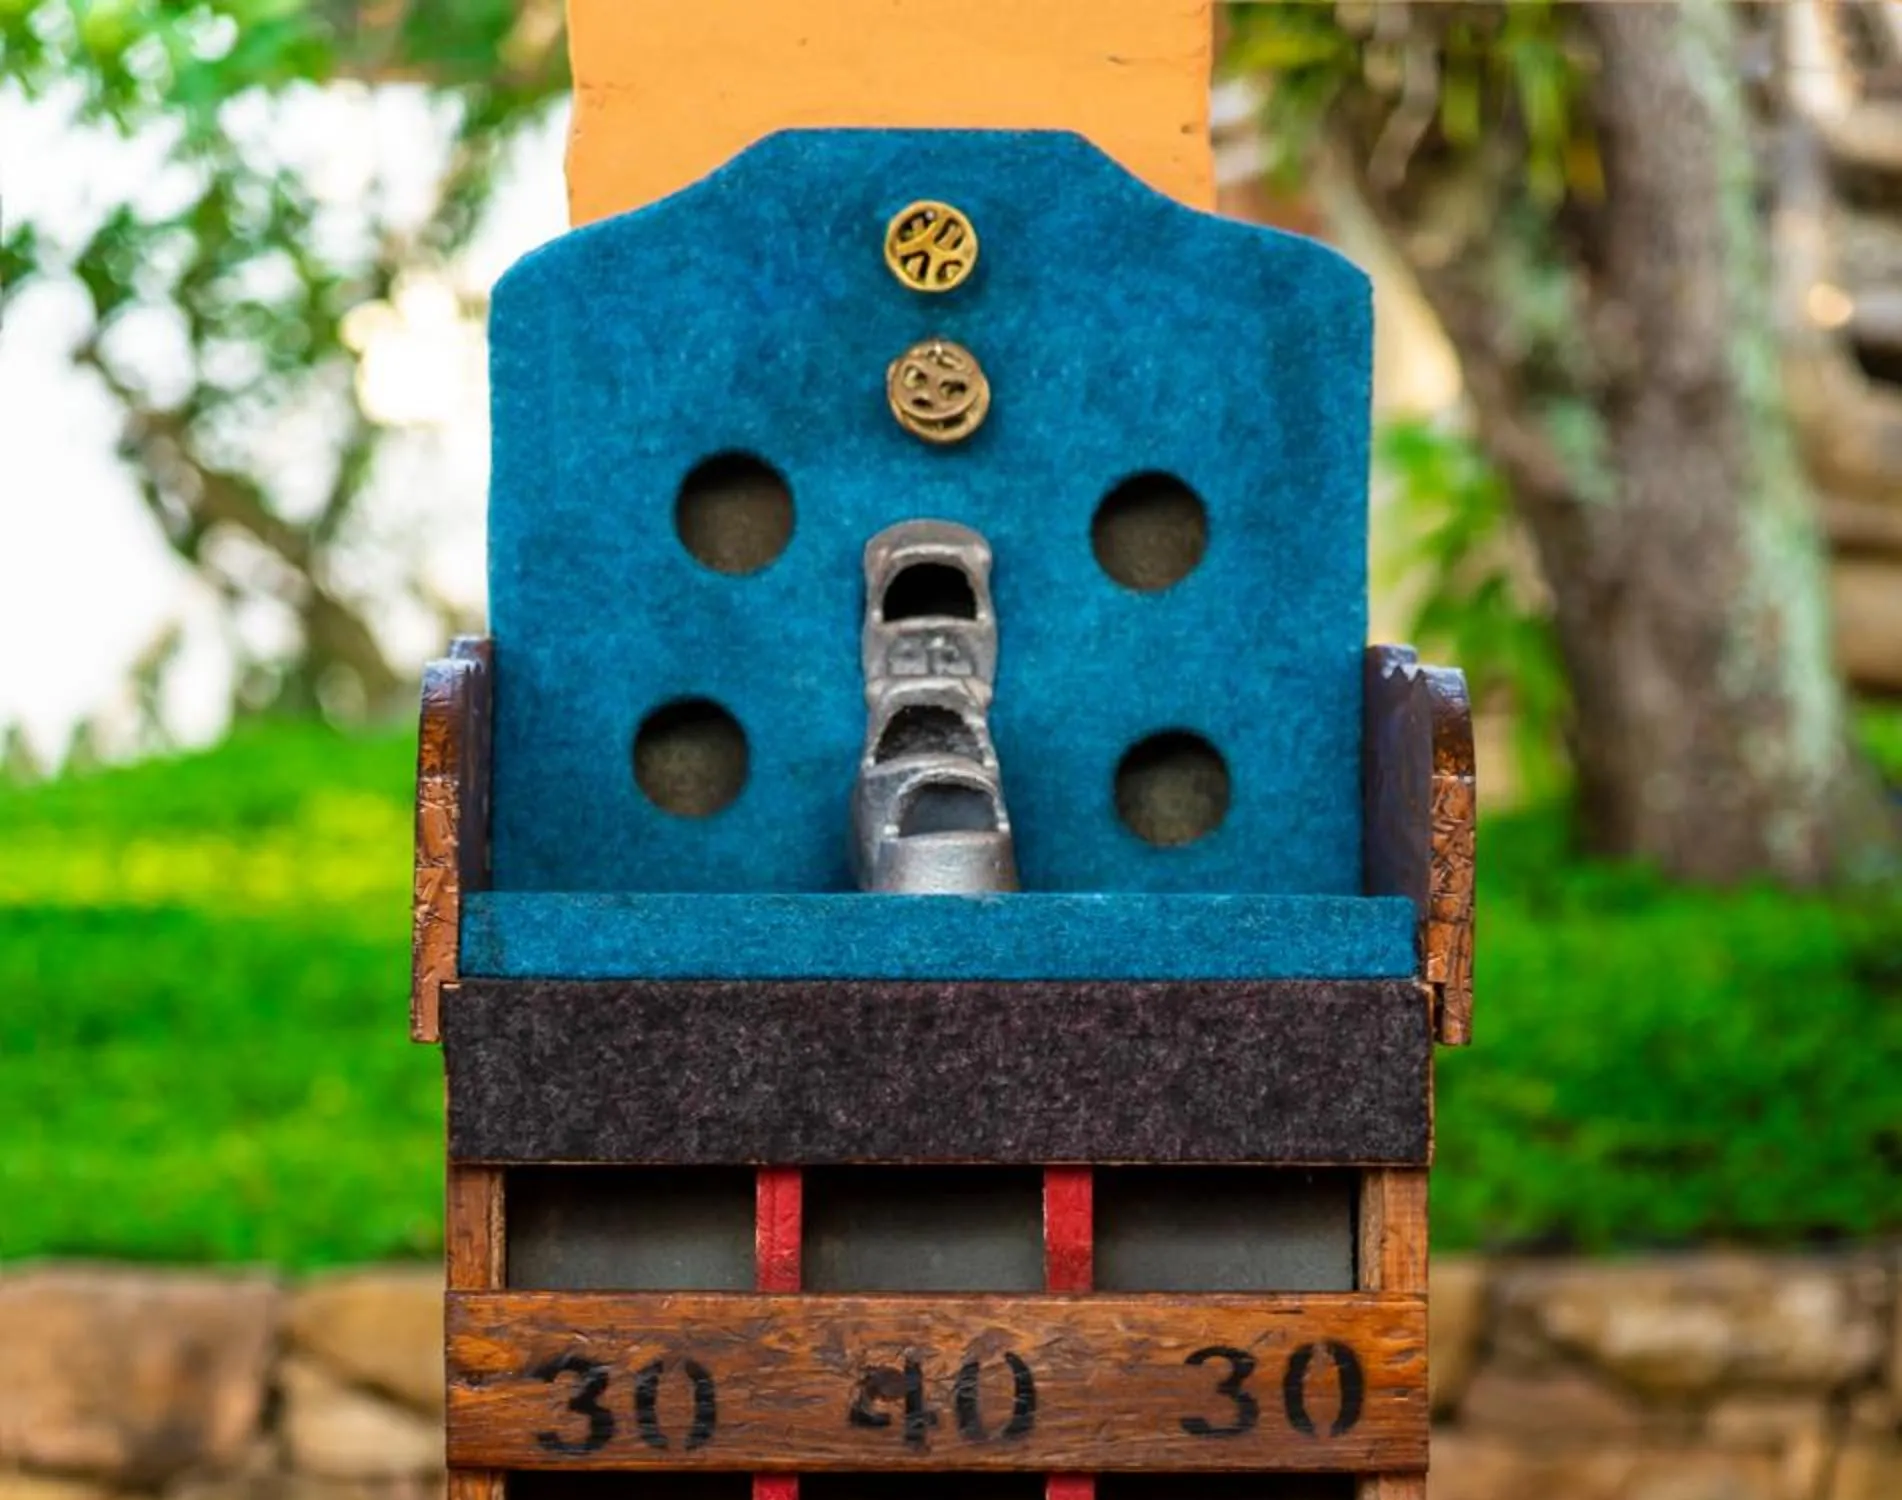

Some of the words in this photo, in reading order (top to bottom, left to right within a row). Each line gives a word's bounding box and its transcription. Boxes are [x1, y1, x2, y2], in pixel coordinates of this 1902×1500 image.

[530, 1354, 718, 1454] 30
[848, 1348, 1039, 1450] 40
[1179, 1338, 1367, 1440] 30
